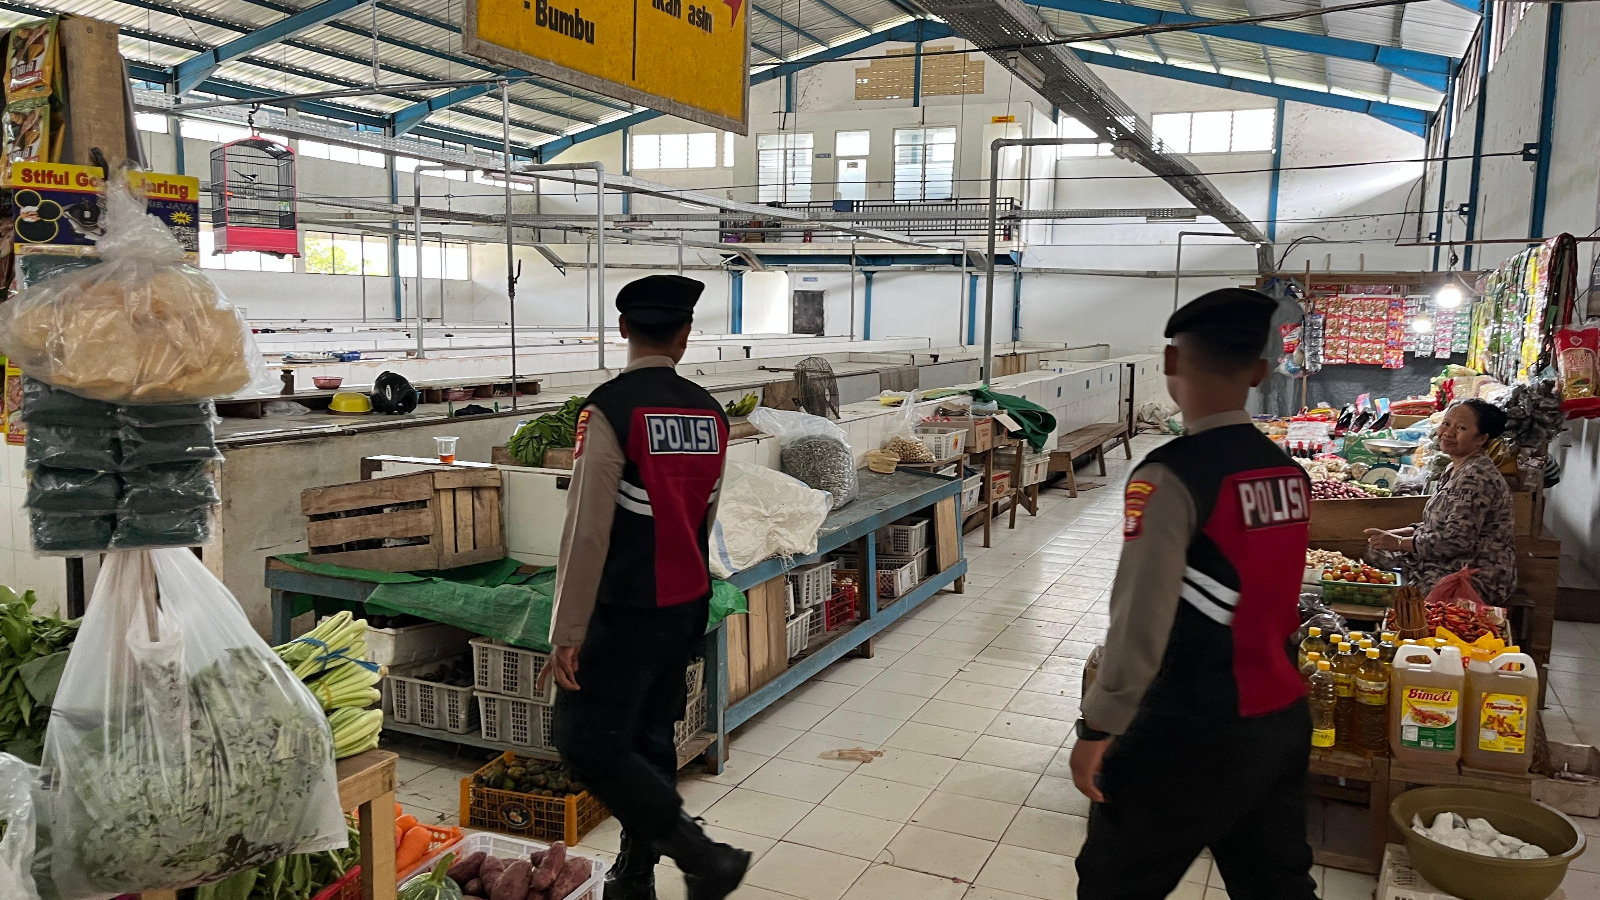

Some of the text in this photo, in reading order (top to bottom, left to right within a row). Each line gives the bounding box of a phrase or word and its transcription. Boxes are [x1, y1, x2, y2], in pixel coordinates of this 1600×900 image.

[535, 0, 595, 45] Bumbu
[652, 0, 713, 33] an asin
[21, 168, 69, 186] Stiful
[75, 172, 101, 188] Go
[650, 418, 717, 451] POLISI
[1238, 478, 1308, 525] POLISI
[1407, 688, 1453, 702] Bimoli
